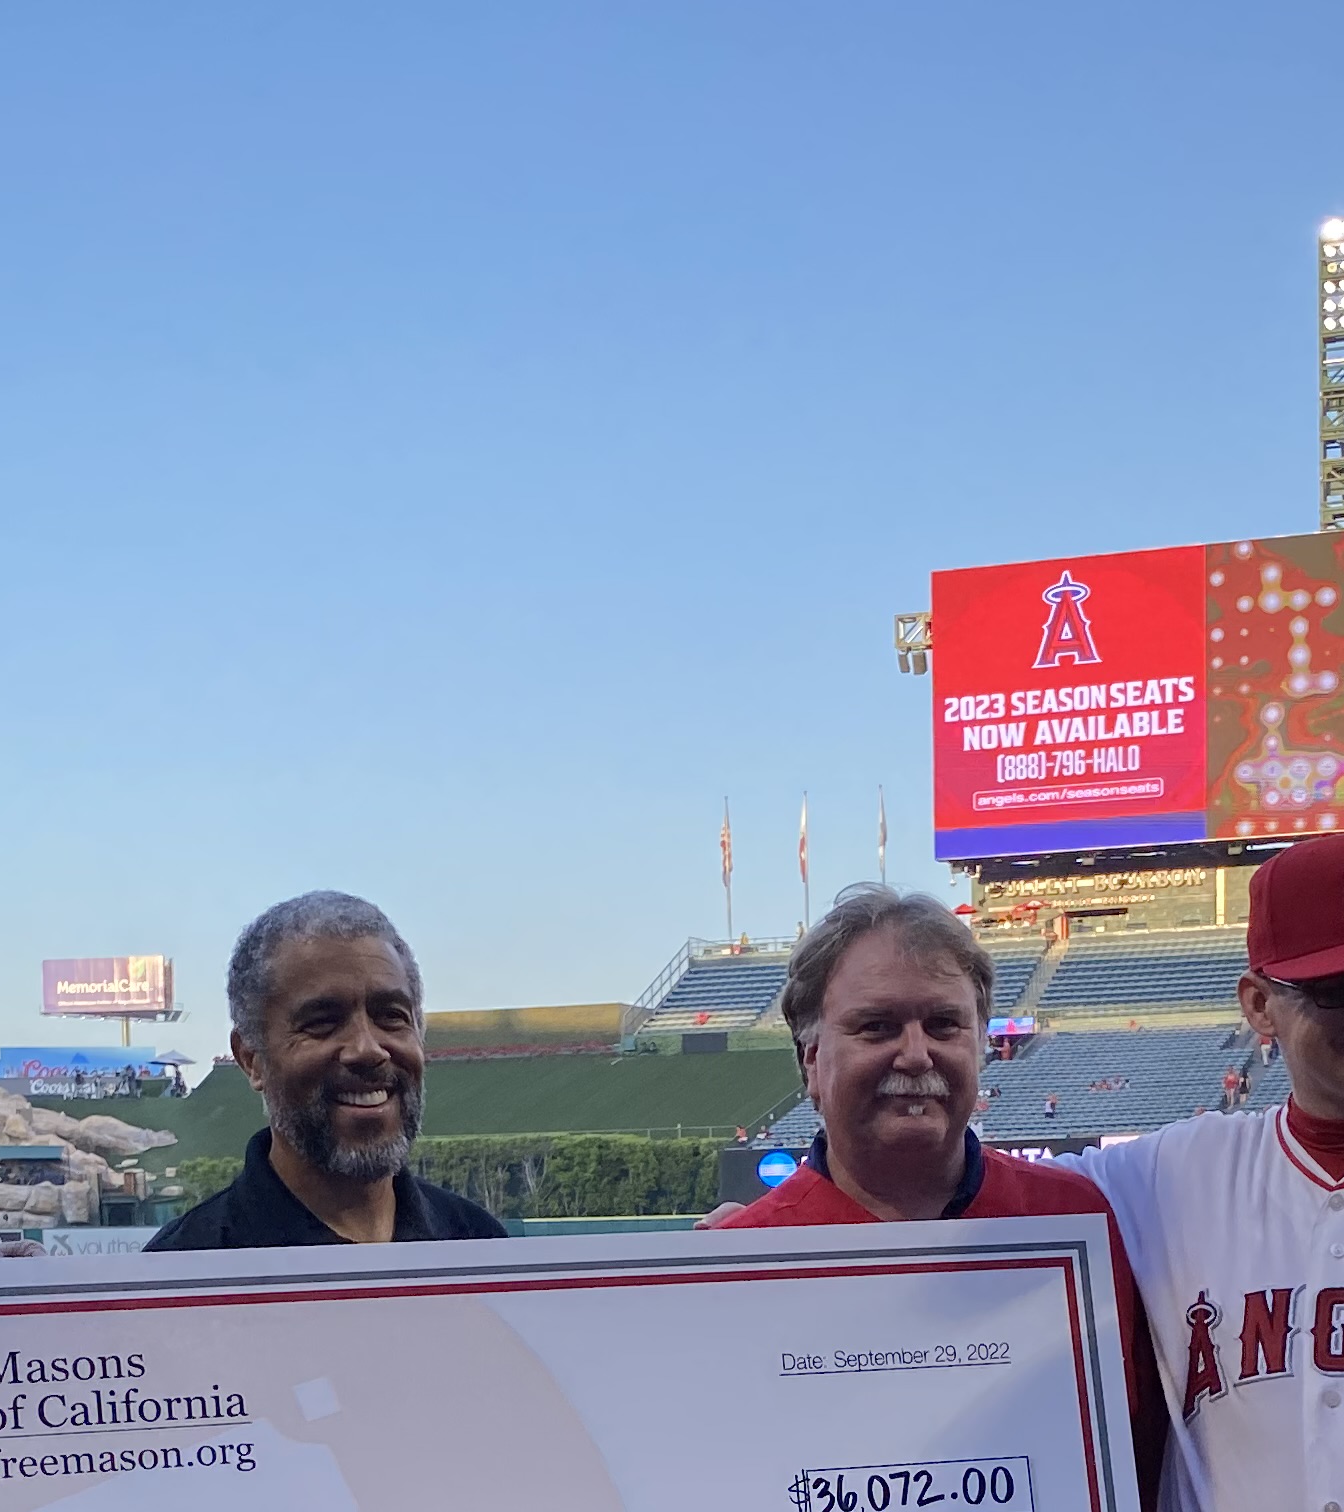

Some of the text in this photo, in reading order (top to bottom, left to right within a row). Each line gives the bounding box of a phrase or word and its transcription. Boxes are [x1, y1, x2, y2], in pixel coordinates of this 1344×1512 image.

[944, 676, 1196, 723] 2023 SEASON SEATS
[963, 709, 1185, 751] NOW AVAILABLE
[996, 745, 1141, 783] (888)-796-HALO
[977, 782, 1160, 808] angels.com/seasonseats
[56, 979, 150, 994] MemorialCare
[781, 1342, 1011, 1371] Date: September 29, 2022
[37, 1384, 250, 1428] California
